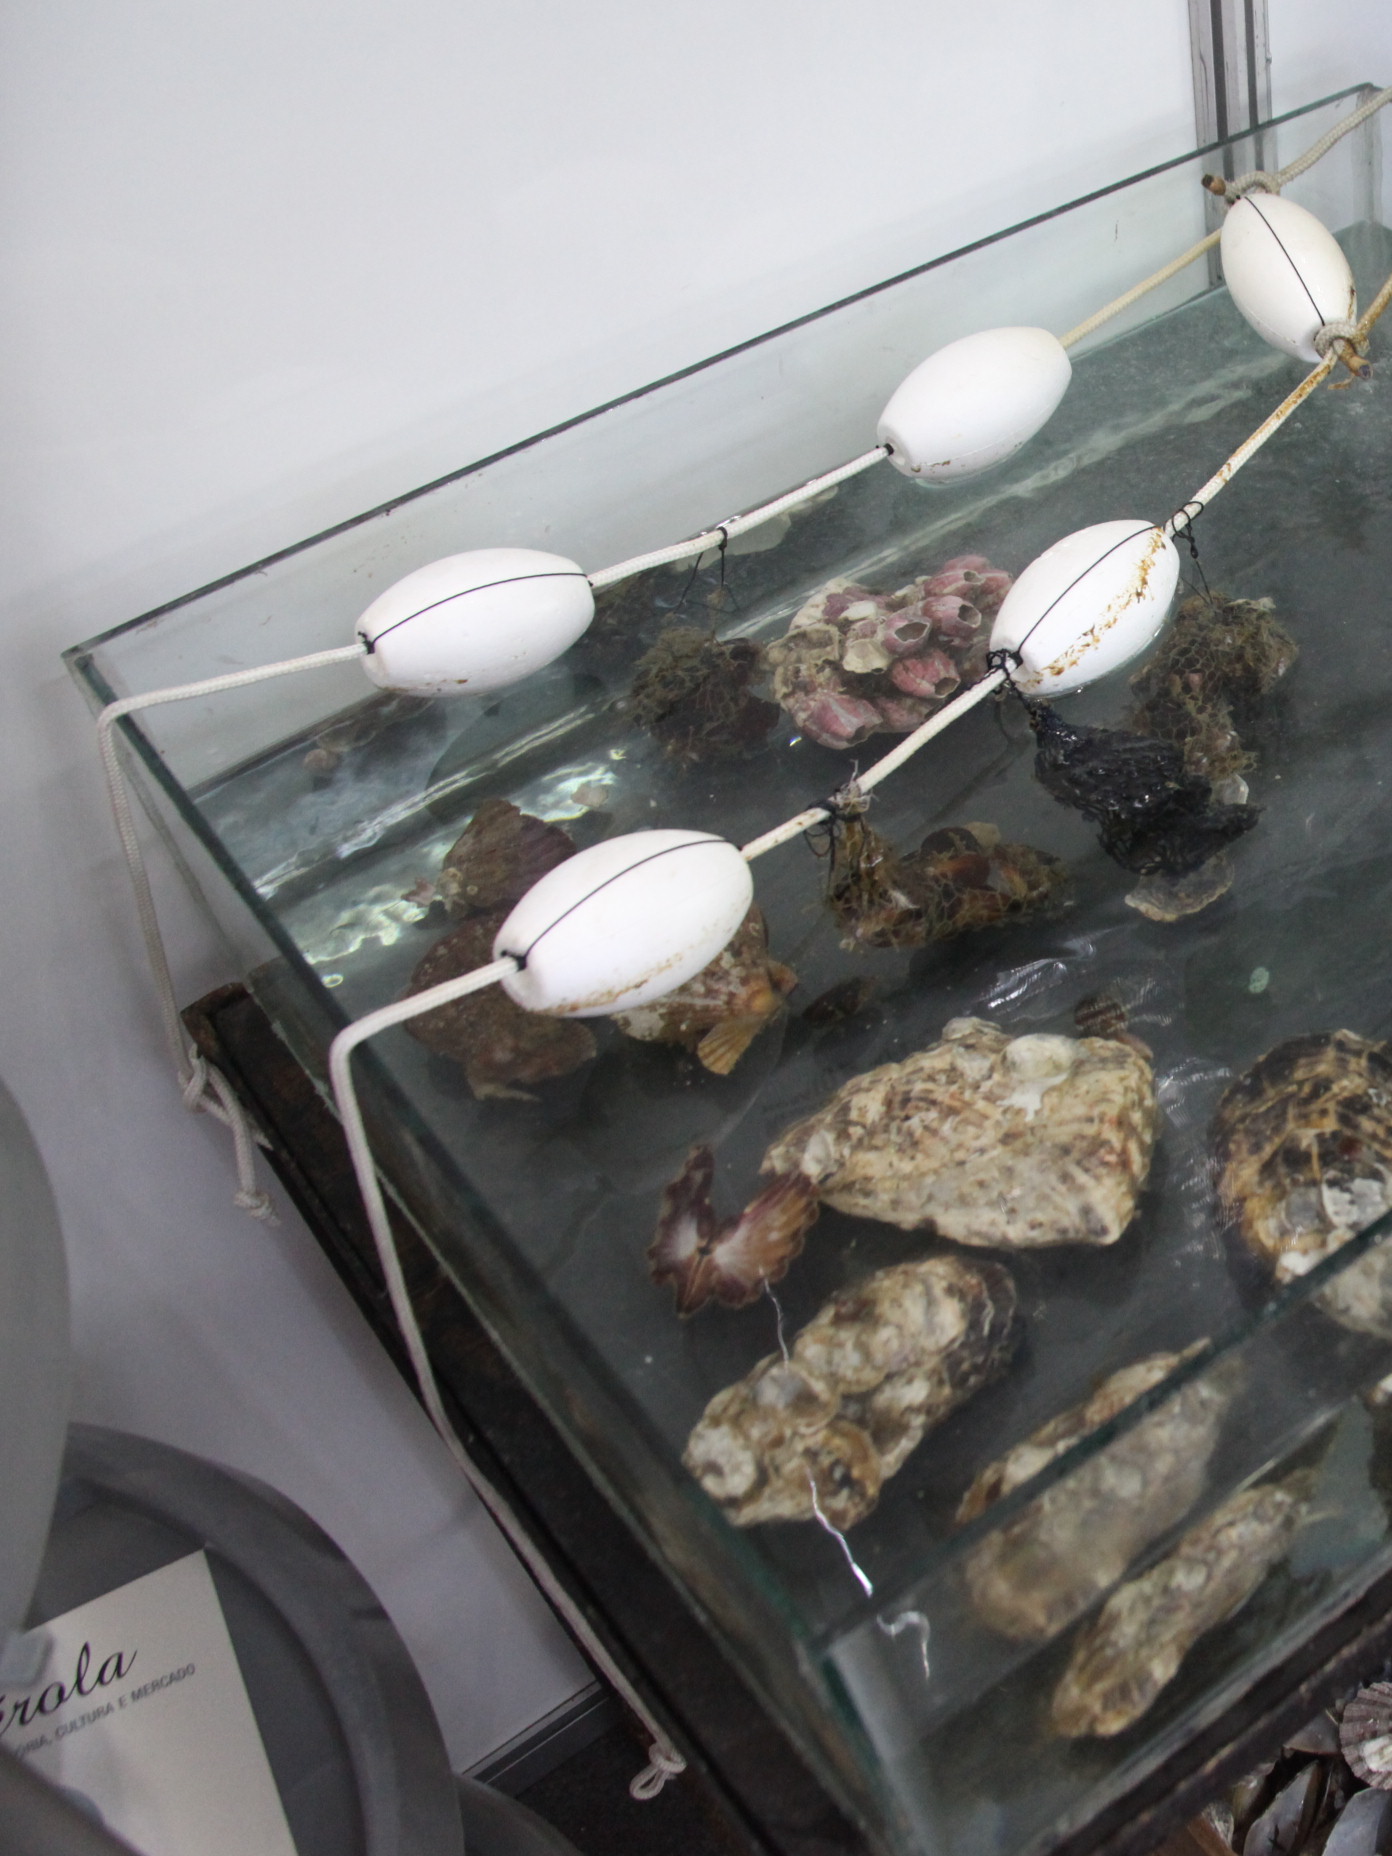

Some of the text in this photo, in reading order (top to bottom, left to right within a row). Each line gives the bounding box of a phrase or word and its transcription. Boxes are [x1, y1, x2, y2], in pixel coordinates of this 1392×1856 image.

[54, 1701, 116, 1742] CULTURA
[117, 1696, 129, 1712] E
[130, 1662, 197, 1702] MERCADO
